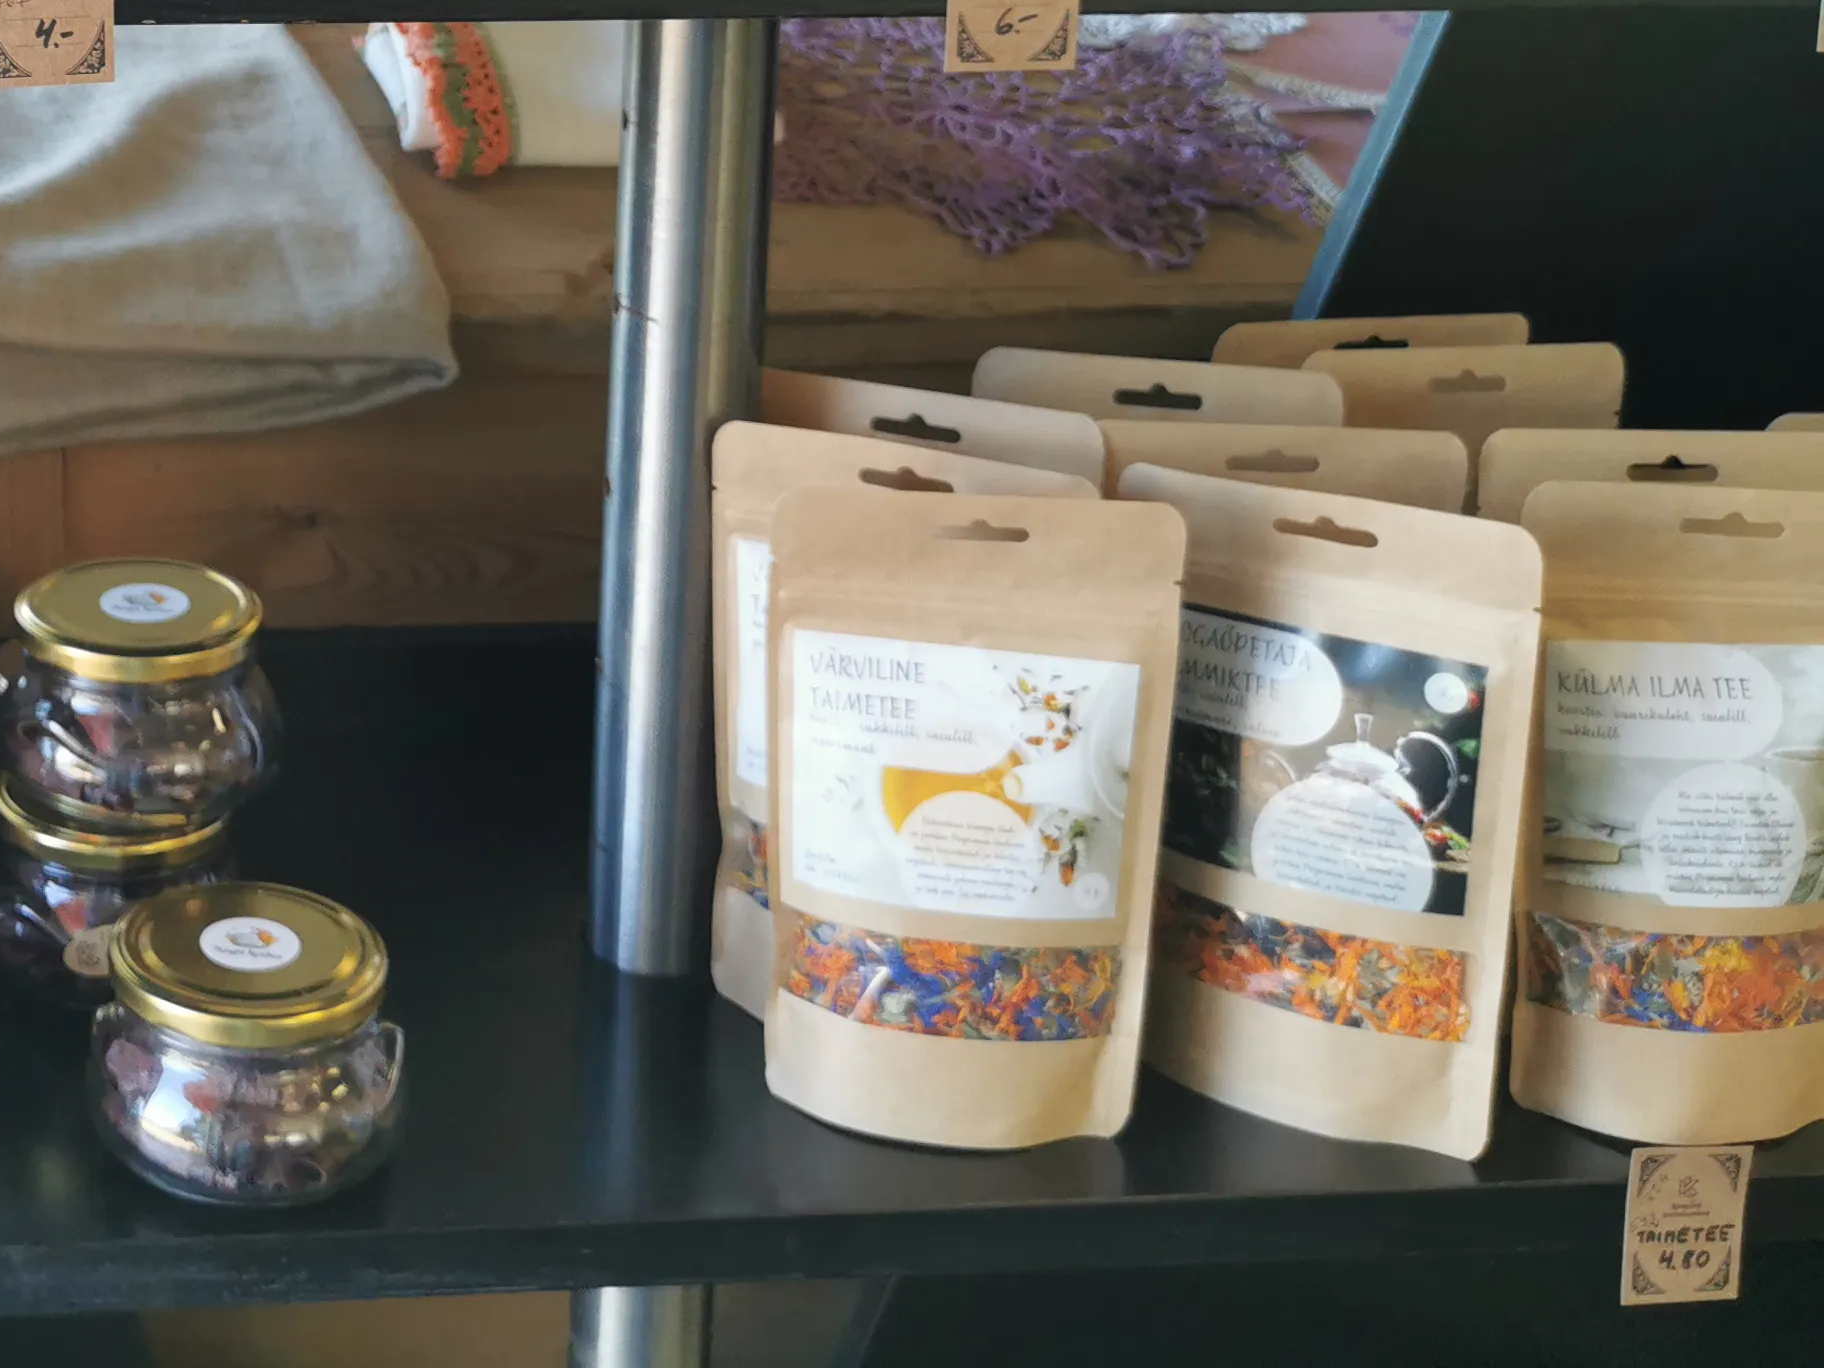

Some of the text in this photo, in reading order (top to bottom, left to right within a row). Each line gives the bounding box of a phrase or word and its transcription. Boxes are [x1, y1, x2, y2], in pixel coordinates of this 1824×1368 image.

[1181, 619, 1312, 672] OGAÕPETAJA
[809, 646, 925, 684] VÄRVILINE
[1180, 658, 1282, 703] MMIKTEE
[1557, 668, 1753, 700] KÜLMA ILMA TEE
[809, 686, 917, 720] TAIMETEE
[1636, 1223, 1736, 1245] TAIMETEE
